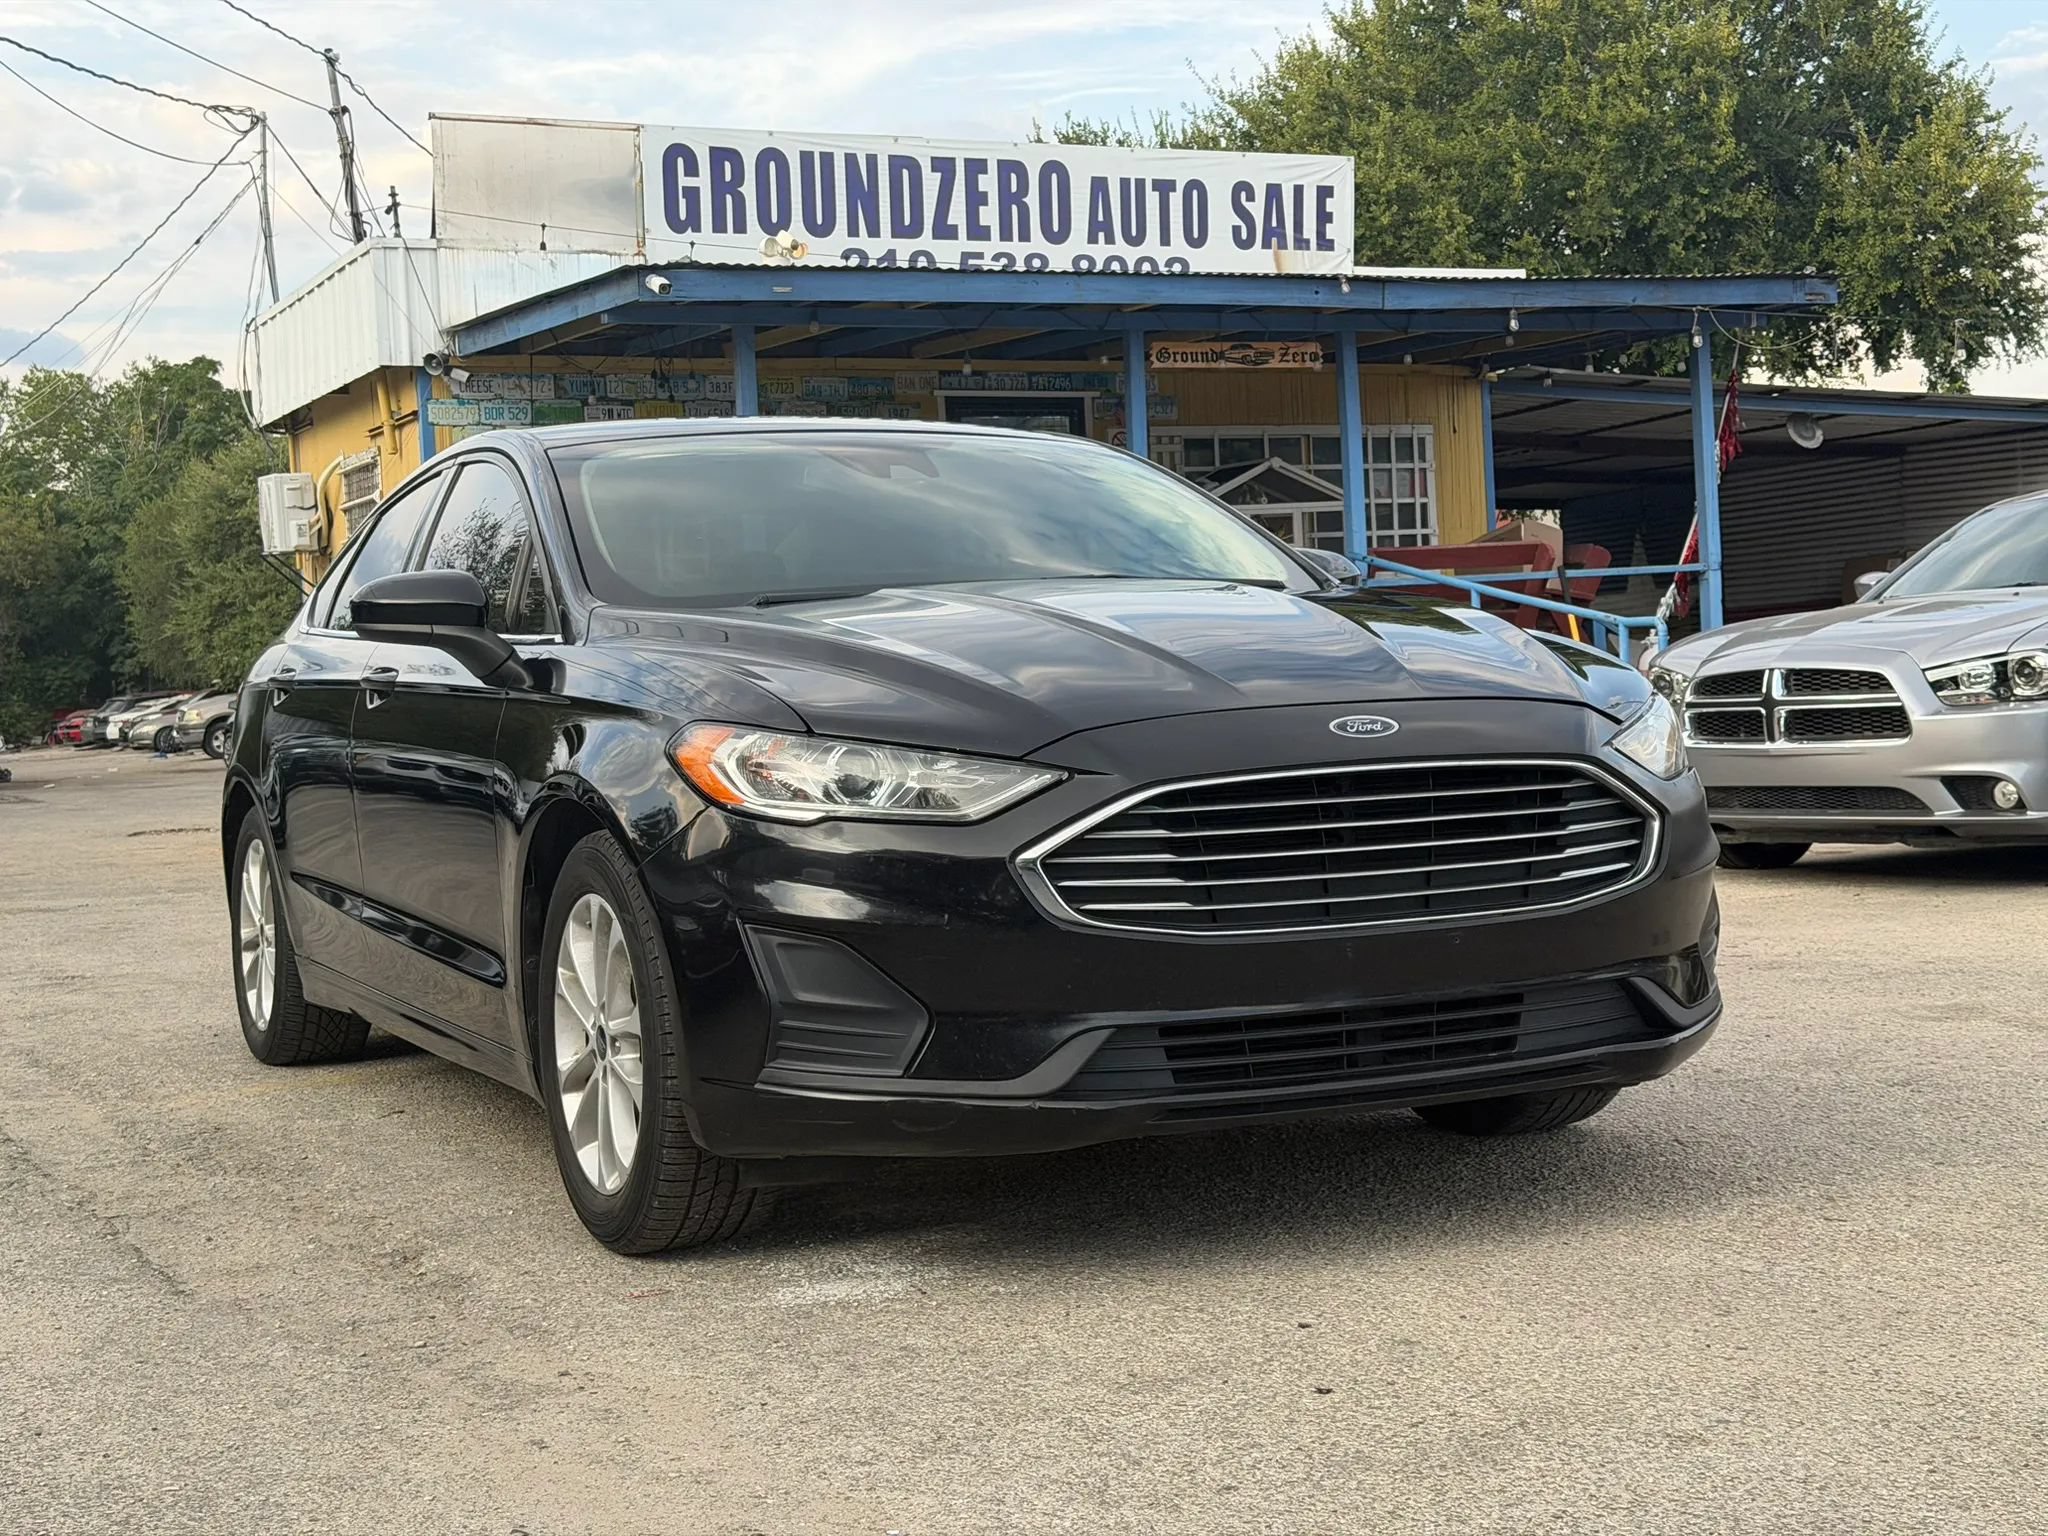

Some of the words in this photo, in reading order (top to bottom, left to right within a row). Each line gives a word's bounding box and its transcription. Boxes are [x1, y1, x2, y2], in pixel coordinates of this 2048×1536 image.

[662, 142, 1072, 245] GROUNDZERO
[1087, 176, 1209, 250] AUTO
[1231, 180, 1335, 251] SALE
[1155, 346, 1219, 364] Ground
[1278, 348, 1318, 364] Zero
[1346, 719, 1384, 733] Ford
